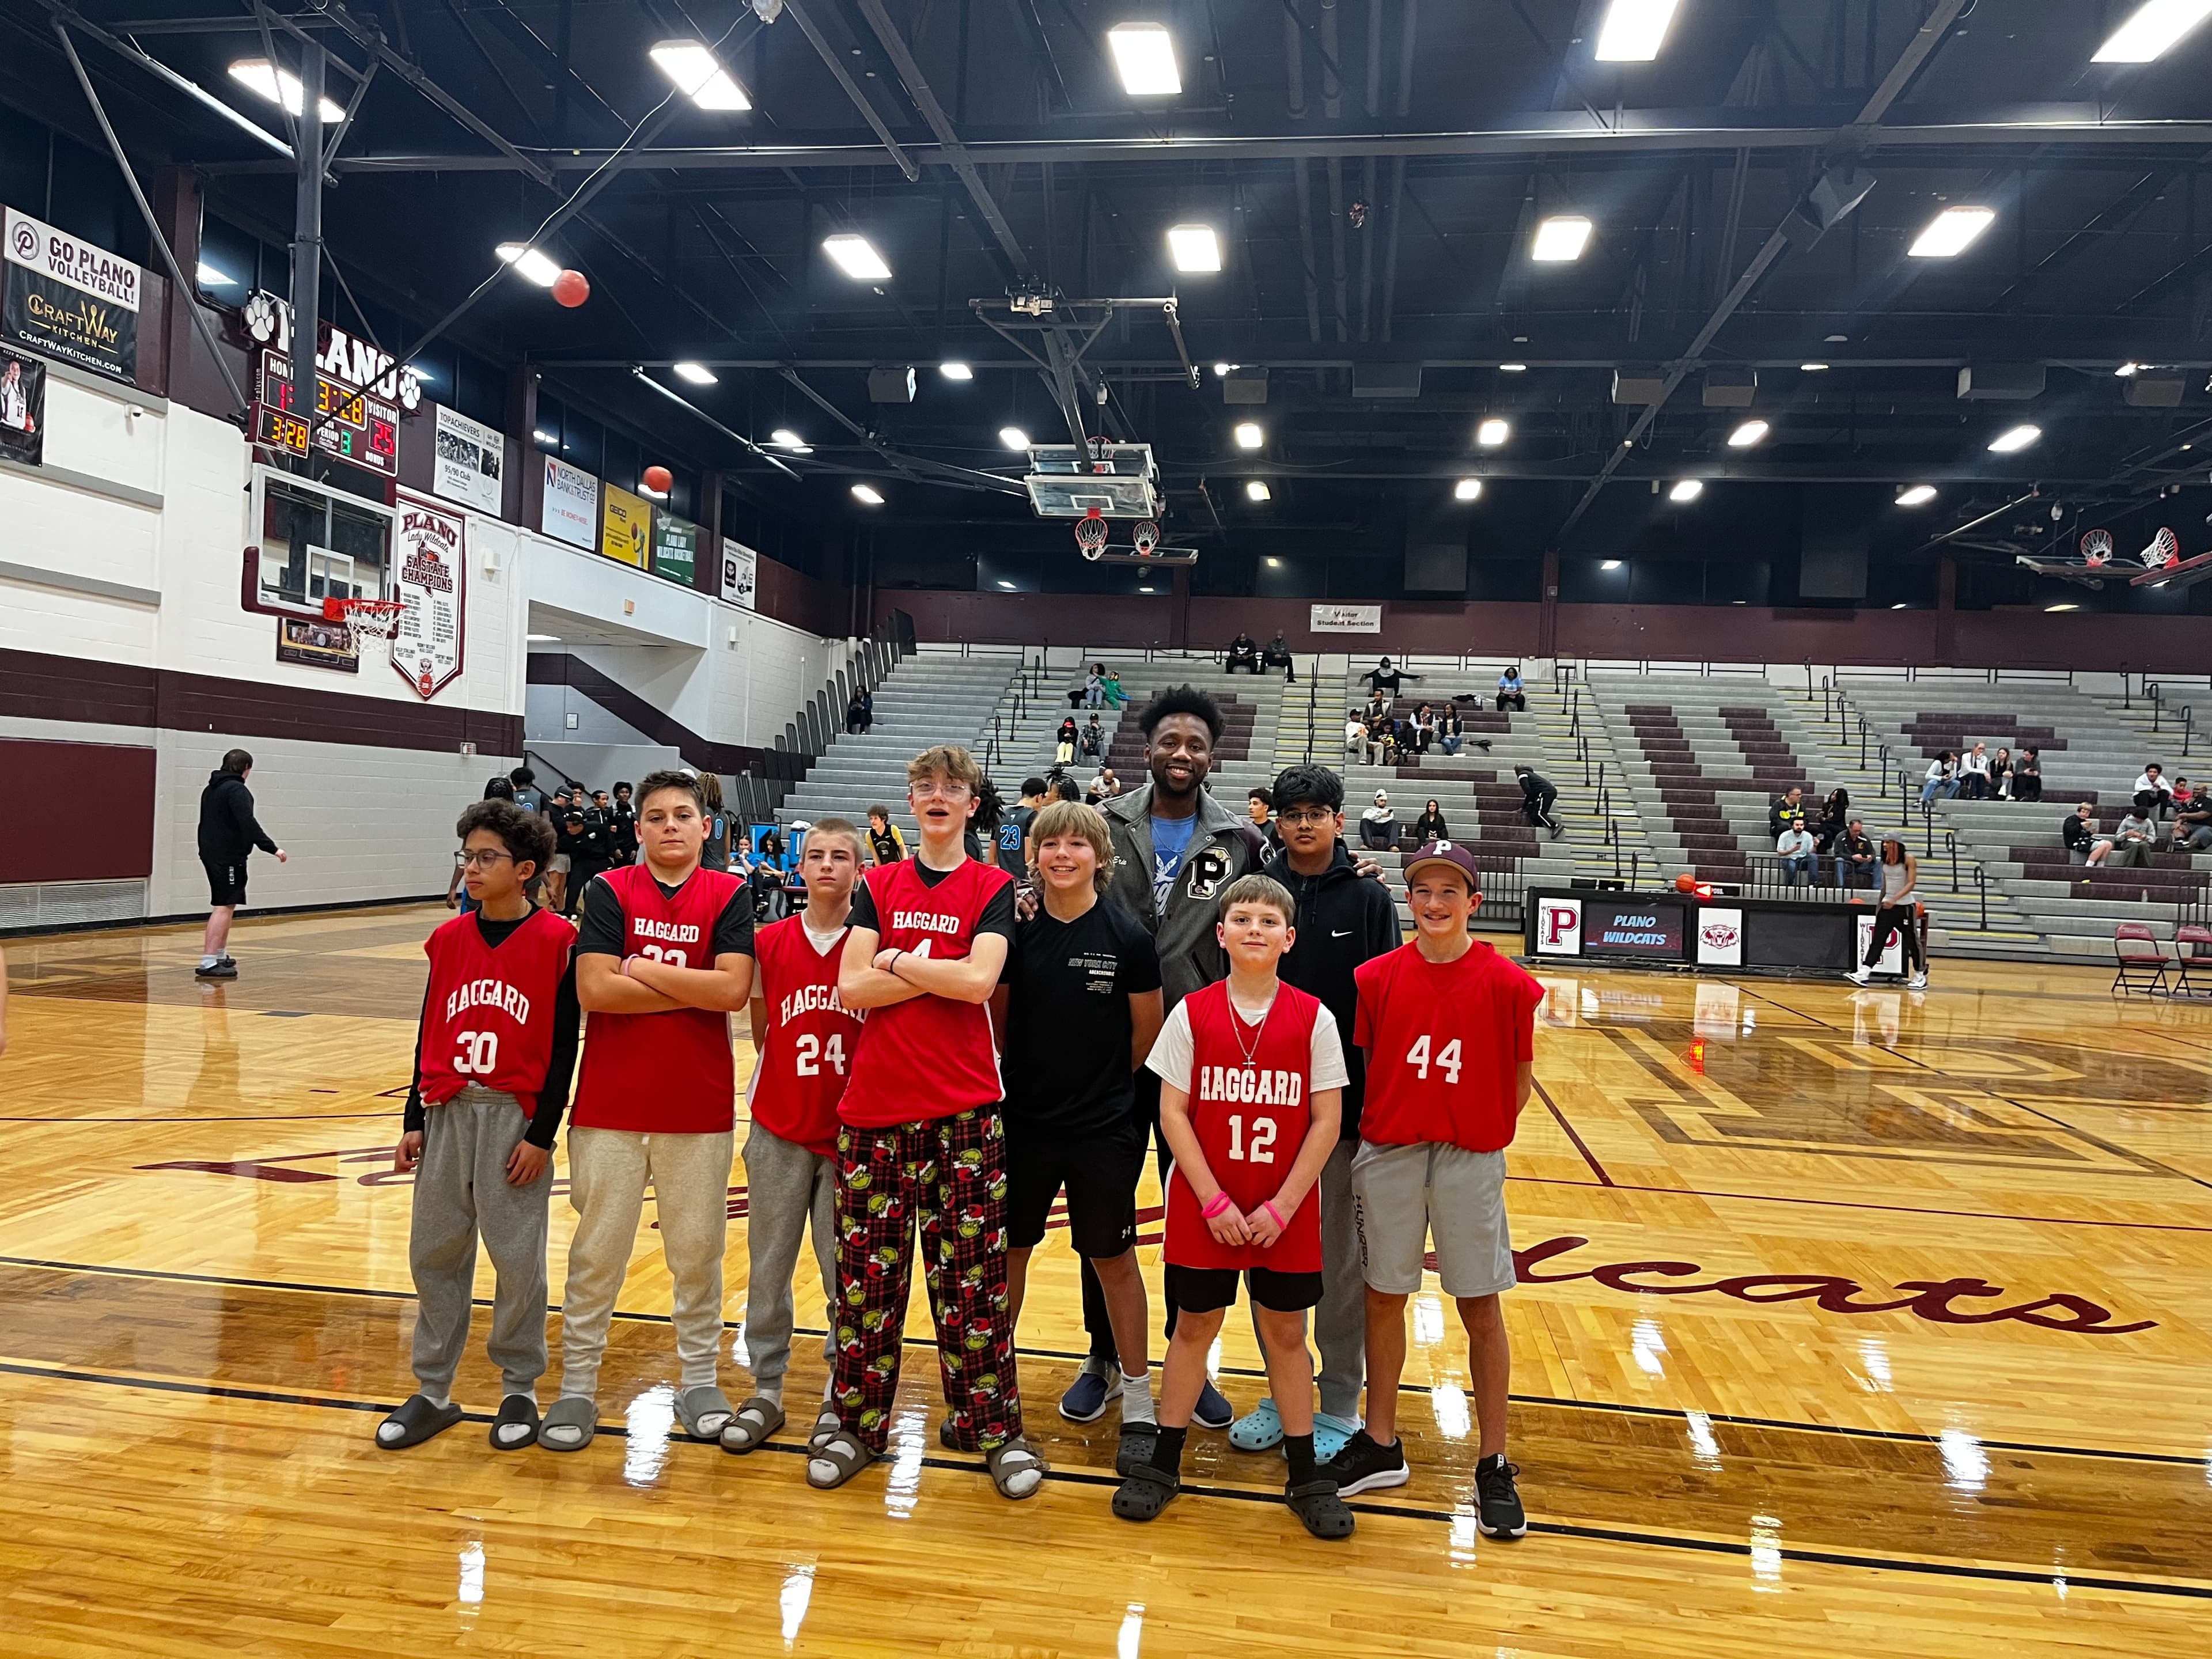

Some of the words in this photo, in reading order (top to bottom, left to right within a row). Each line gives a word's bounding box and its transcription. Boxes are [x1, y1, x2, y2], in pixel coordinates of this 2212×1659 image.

[50, 237, 74, 263] GO
[80, 249, 135, 289] PLANO
[48, 256, 134, 304] VOLLEYBALL!
[52, 326, 97, 348] KITCHEN
[368, 400, 397, 425] VISITOR
[271, 416, 307, 449] 3:28
[342, 430, 351, 456] 3
[373, 422, 395, 456] 25
[365, 451, 385, 467] BONUS
[460, 471, 471, 481] Club
[557, 467, 576, 482] NORTH
[577, 475, 596, 493] DALLAS
[400, 512, 459, 547] PLANO
[408, 530, 423, 546] Lady
[425, 531, 449, 553] Wildcats
[402, 567, 453, 591] CHAMPIONS
[407, 555, 419, 570] 6A
[421, 559, 449, 578] STATE
[1000, 824, 1020, 850] 23
[1433, 840, 1452, 855] P
[1187, 846, 1233, 900] P
[634, 917, 700, 943] HAGGARD
[892, 911, 960, 934] HAGGARD
[1546, 906, 1579, 946] P
[1613, 915, 1657, 928] PLANO
[1603, 931, 1667, 945] WILDCATS
[1068, 958, 1084, 967] NEW
[446, 979, 530, 1025] HAGGARD
[781, 984, 871, 1027] HAGGA
[453, 1031, 498, 1074] 30
[796, 1033, 857, 1076] 24
[1407, 1035, 1462, 1085] 44
[1200, 1066, 1302, 1107] HAGGARD
[1228, 1115, 1277, 1164] 12
